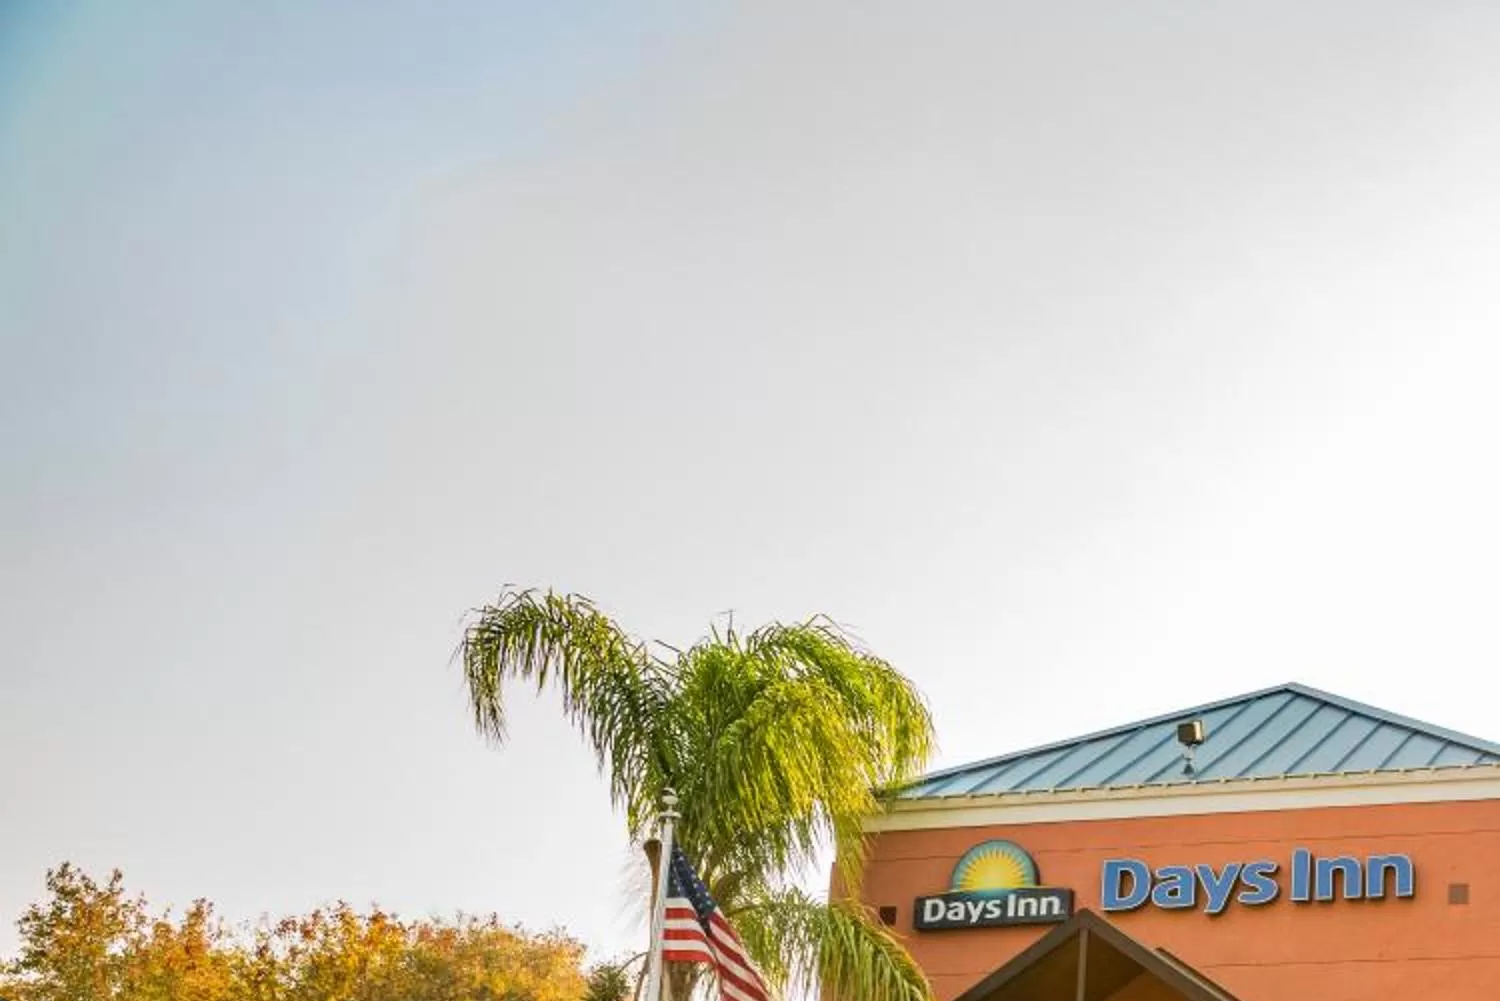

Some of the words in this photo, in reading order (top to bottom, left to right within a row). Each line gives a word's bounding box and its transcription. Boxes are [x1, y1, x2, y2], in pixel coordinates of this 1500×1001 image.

[1101, 858, 1279, 913] Days
[1291, 847, 1413, 901] Inn
[923, 898, 1002, 924] Days
[1007, 893, 1061, 917] Inn
